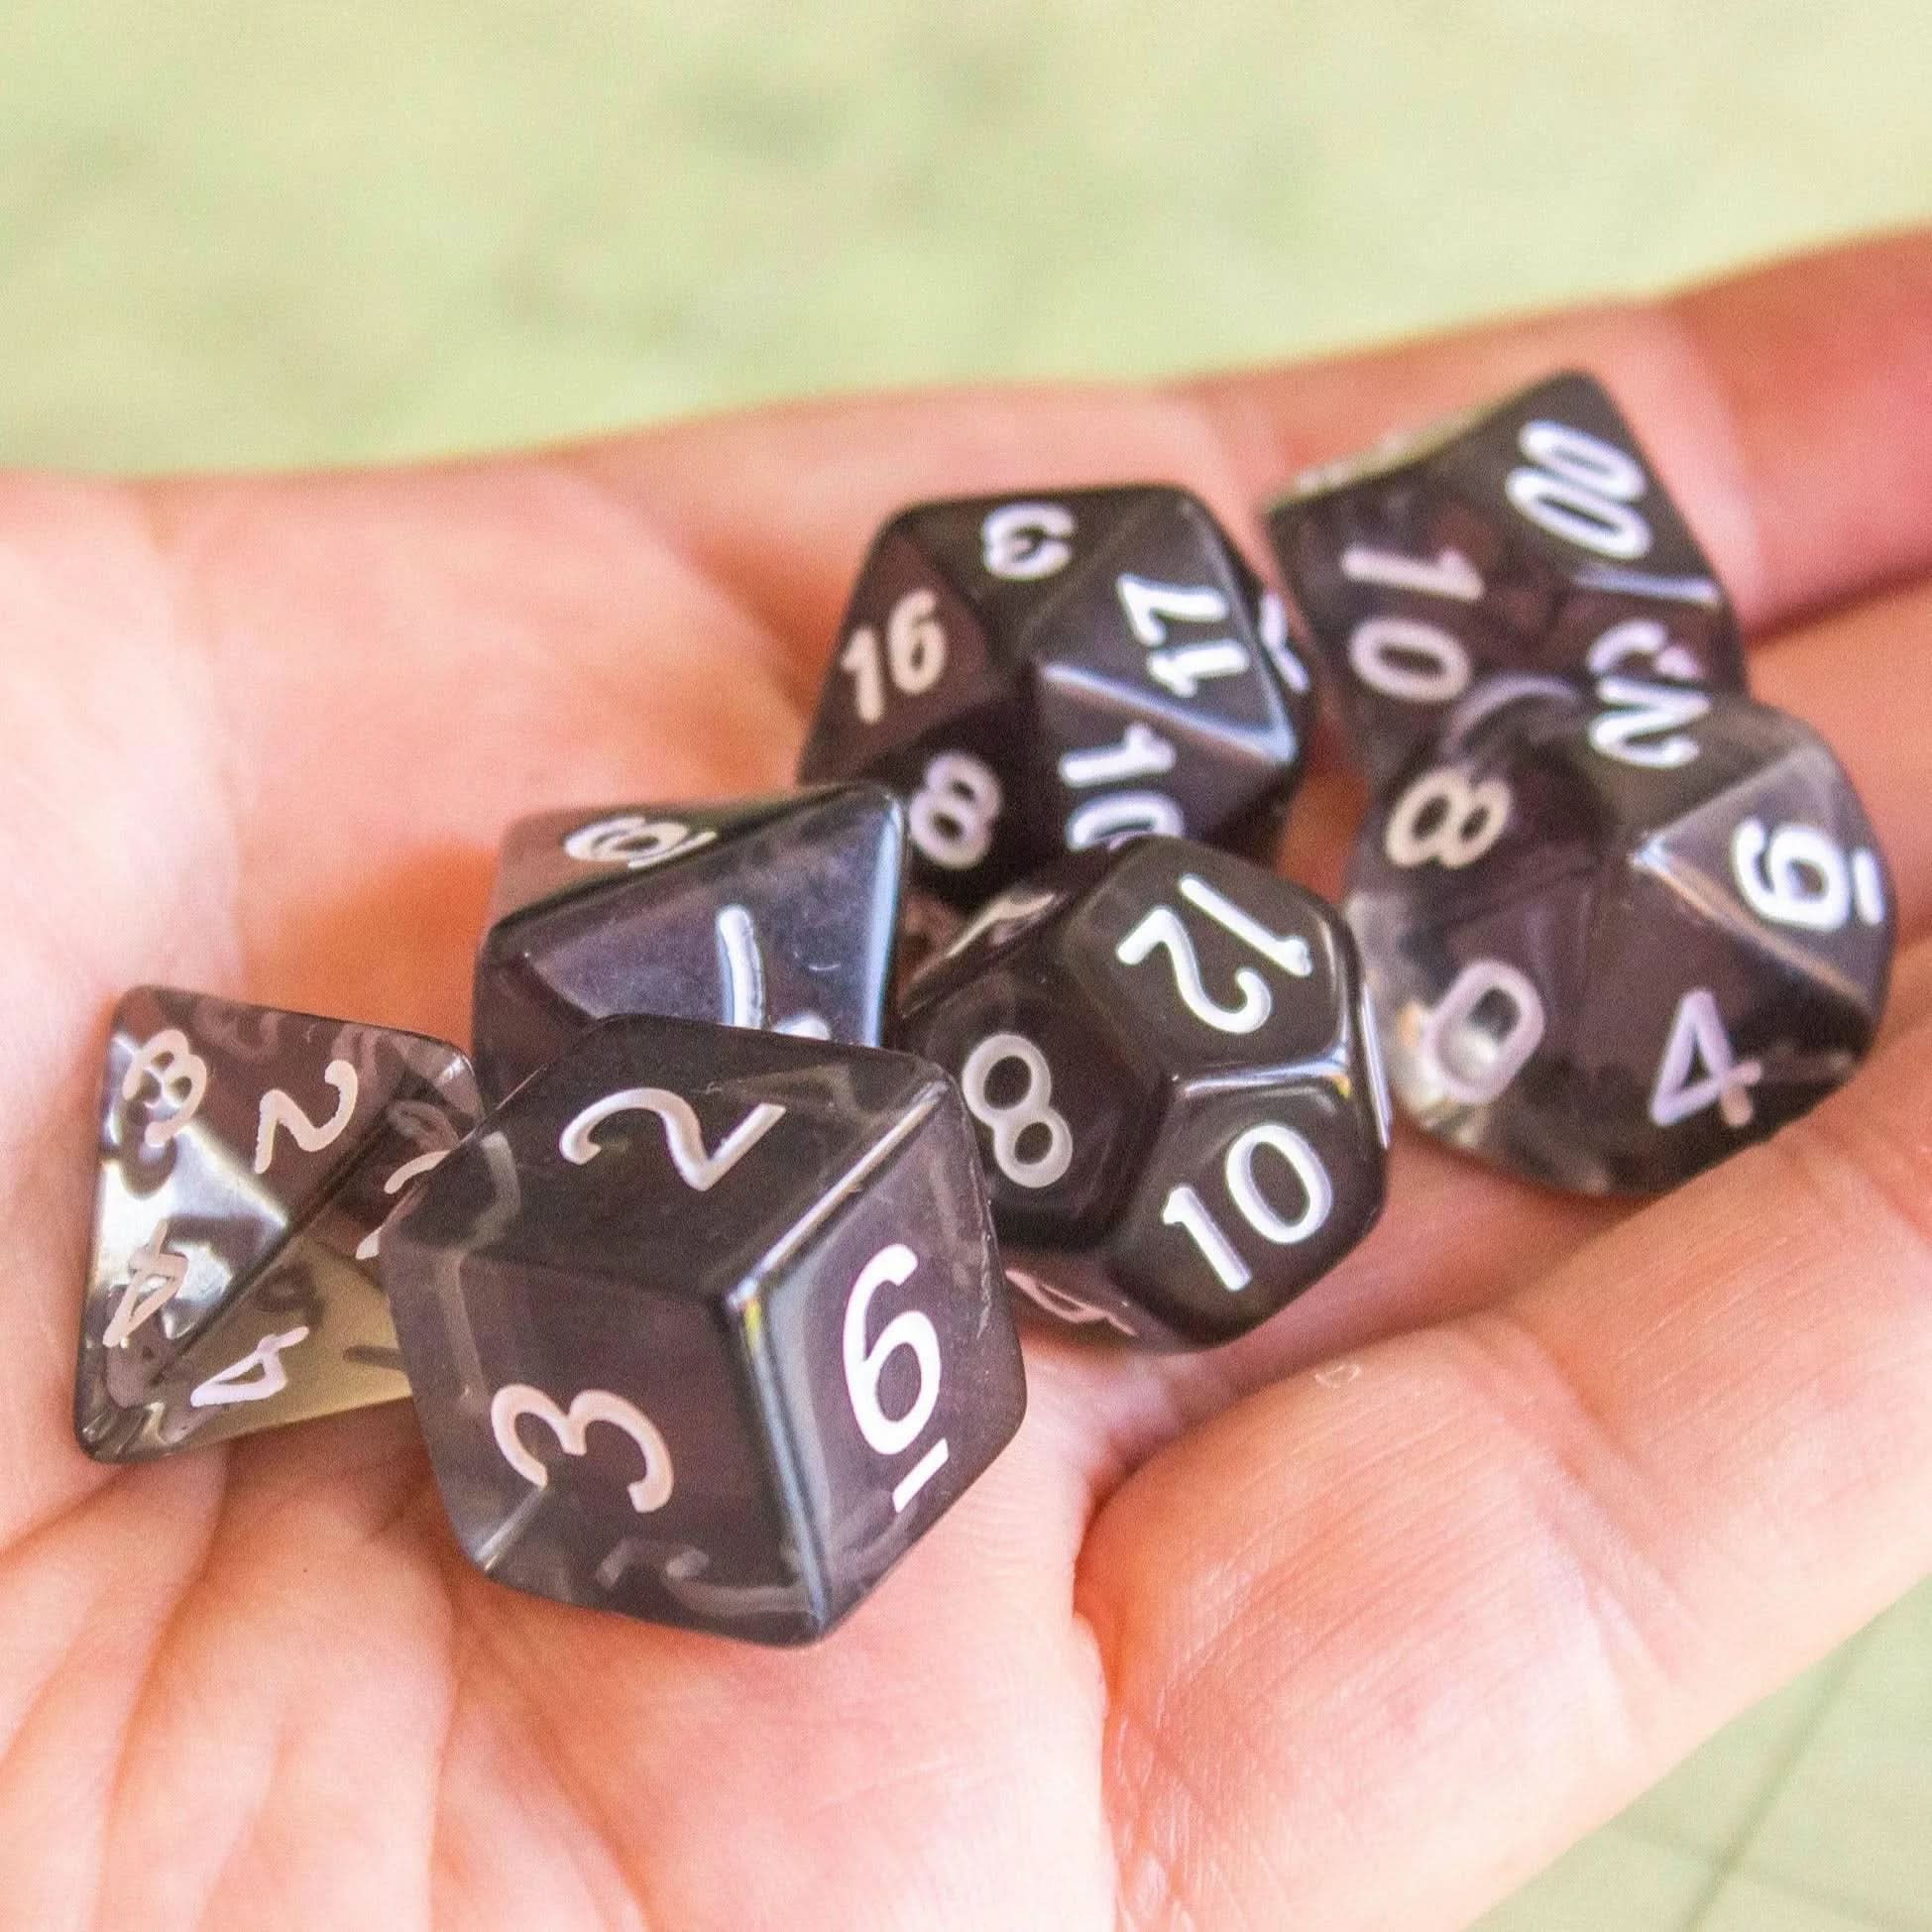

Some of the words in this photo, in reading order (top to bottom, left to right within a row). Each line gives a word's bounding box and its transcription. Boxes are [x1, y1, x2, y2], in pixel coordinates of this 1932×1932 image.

[1506, 420, 1652, 559] 00
[842, 591, 946, 723] 16
[1116, 572, 1251, 698] 17
[1342, 544, 1484, 704] 10
[909, 751, 1002, 869] 8
[1388, 767, 1512, 868] 8
[1116, 874, 1312, 1034] 12
[1421, 961, 1543, 1105] 0
[1648, 990, 1762, 1128] 4
[254, 1060, 358, 1174] 2
[559, 1087, 787, 1191] 2
[962, 1033, 1073, 1188] 8
[1163, 1124, 1332, 1291] 10
[190, 1326, 309, 1408] 4
[490, 1384, 674, 1513] 3
